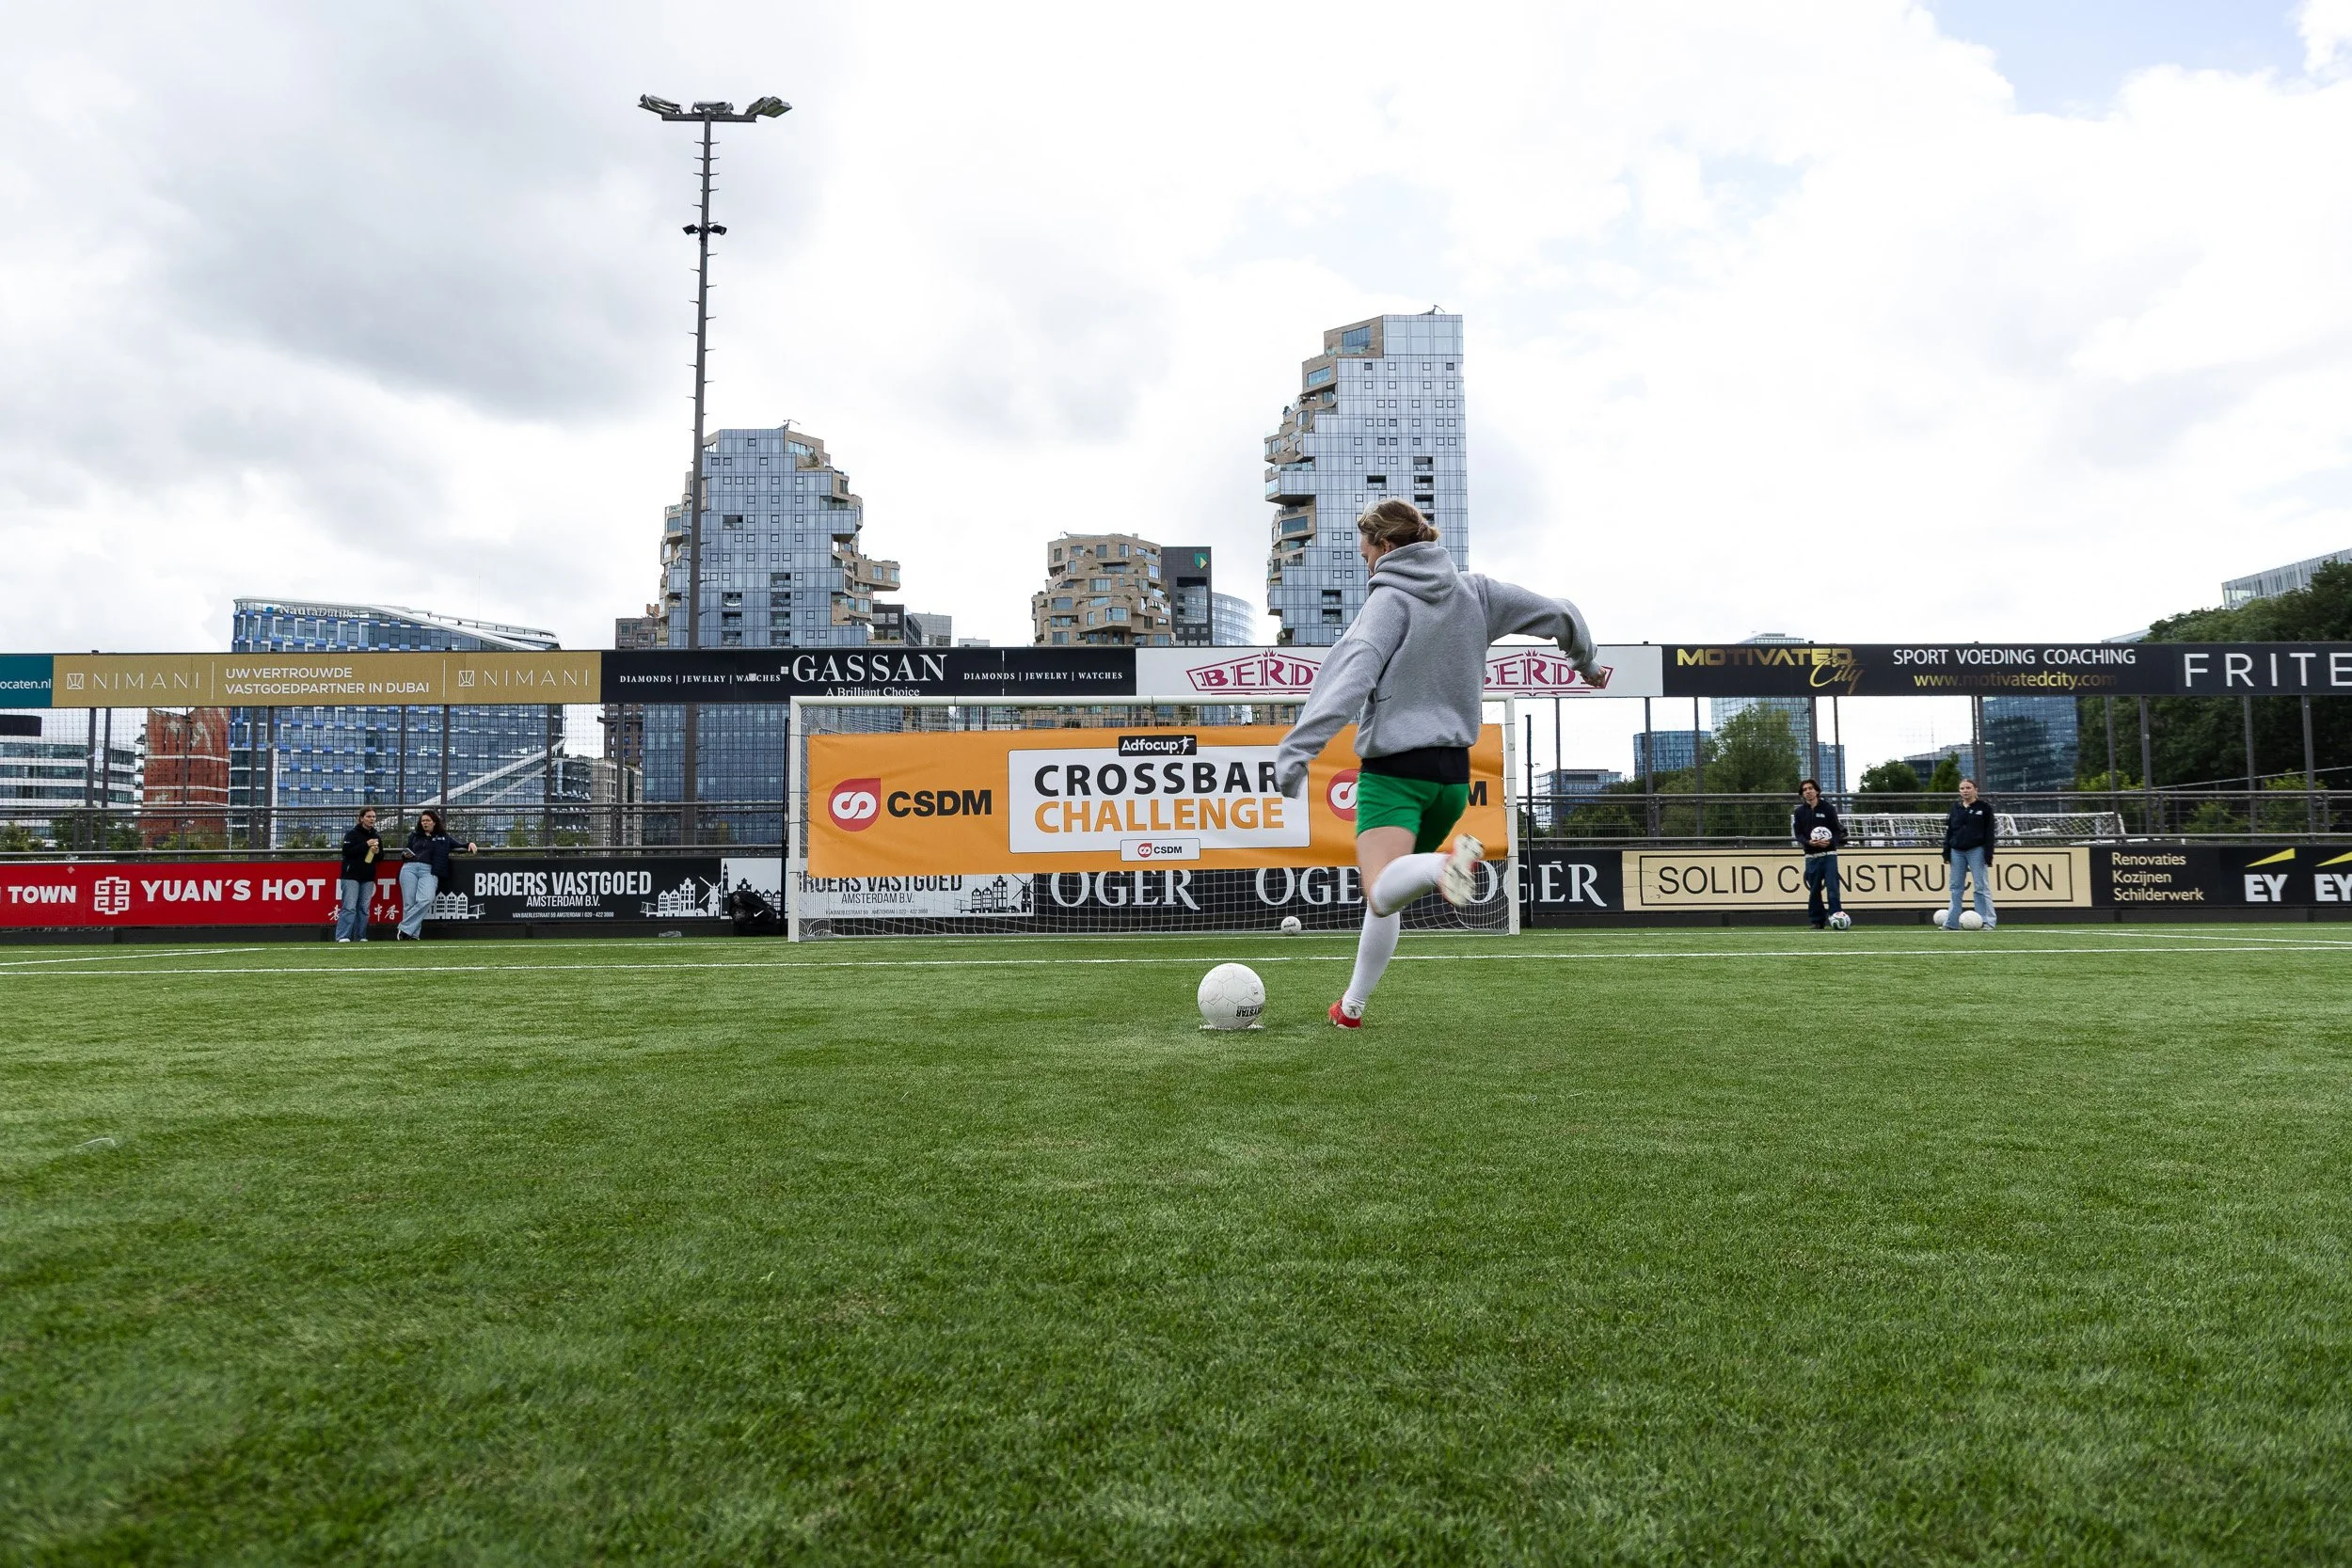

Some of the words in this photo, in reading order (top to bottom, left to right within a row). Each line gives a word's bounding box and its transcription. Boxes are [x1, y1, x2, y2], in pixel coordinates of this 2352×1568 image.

[1677, 648, 1852, 666] MOTIVATED
[1893, 649, 1948, 665] SPORT
[1956, 648, 2035, 665] VOEDING
[2043, 648, 2136, 665] COACHING
[226, 668, 250, 679] UW
[253, 667, 353, 679] VERTROUWDE
[792, 654, 947, 683] GASSAN
[1025, 672, 1068, 681] JEWELRY
[1079, 672, 1122, 680] WATCHES
[1197, 658, 1319, 687] BERD
[1809, 657, 1866, 695] City
[93, 672, 199, 689] NIMANI
[484, 670, 588, 687] NIMANI
[736, 674, 781, 683] WACHES
[1914, 671, 2116, 690] www.motivatedcity.com
[226, 683, 366, 694] VASTGOEDPARTNER
[369, 683, 382, 693] IN
[387, 682, 429, 693] DUBAI
[826, 688, 834, 696] A
[837, 687, 881, 696] Brilliant
[883, 687, 920, 696] Choice
[1120, 738, 1179, 754] Adfocup
[1035, 762, 1281, 797] CROSSBAR
[887, 789, 993, 817] CSDM
[1035, 797, 1284, 833] CHALLENGE
[1153, 846, 1183, 854] CSDM
[2111, 852, 2186, 865] Renovaties
[474, 872, 547, 896] BROERS
[552, 871, 652, 895] VASTGOED
[1255, 866, 1363, 905] OGE
[1659, 865, 1764, 894] SOLID
[1777, 863, 2054, 893] CNSTRUION
[2112, 871, 2172, 886] Kozijnen
[8, 885, 76, 903] TOWN
[140, 879, 251, 902] YUAN'S
[262, 879, 326, 900] HOT
[2113, 888, 2205, 901] Schilderwerk
[2244, 874, 2288, 902] EY
[526, 895, 583, 908] AMSTERDAM
[585, 895, 601, 907] B.V.
[842, 894, 898, 904] AMSTERDAM
[899, 893, 914, 903] B.V.
